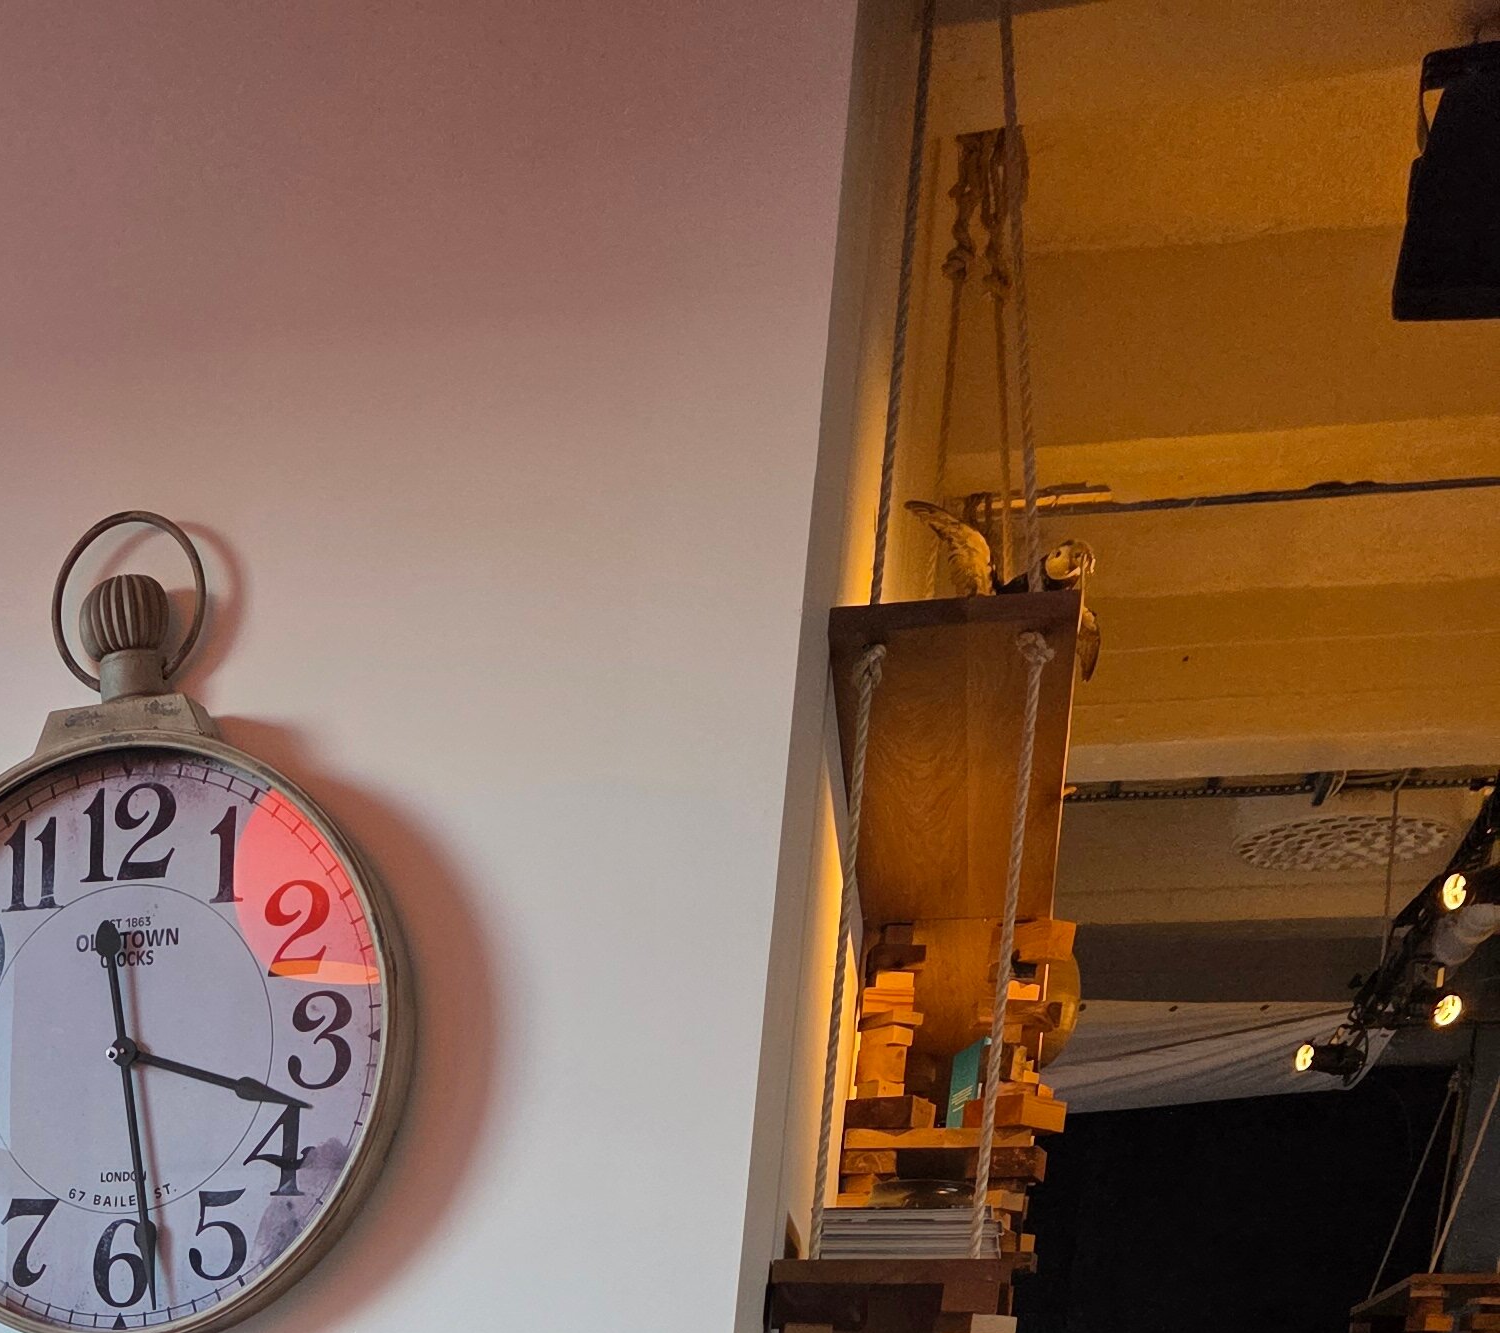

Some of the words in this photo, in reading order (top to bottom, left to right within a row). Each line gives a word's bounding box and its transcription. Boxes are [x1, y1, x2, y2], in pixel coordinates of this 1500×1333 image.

[1, 816, 65, 912] 11
[80, 782, 177, 882] 12
[209, 805, 244, 903] 1
[76, 933, 105, 952] OL
[120, 928, 179, 949] TOWN
[100, 950, 154, 968] COCKS
[126, 916, 151, 928] 1863
[264, 879, 330, 977] 2
[287, 990, 353, 1090] 3
[68, 1188, 86, 1202] 67
[93, 1194, 139, 1207] BAILE
[154, 1183, 177, 1200] ST.
[243, 1103, 316, 1196] 4
[0, 1198, 61, 1288] 7
[92, 1218, 150, 1308] 6
[188, 1187, 247, 1281] 5
